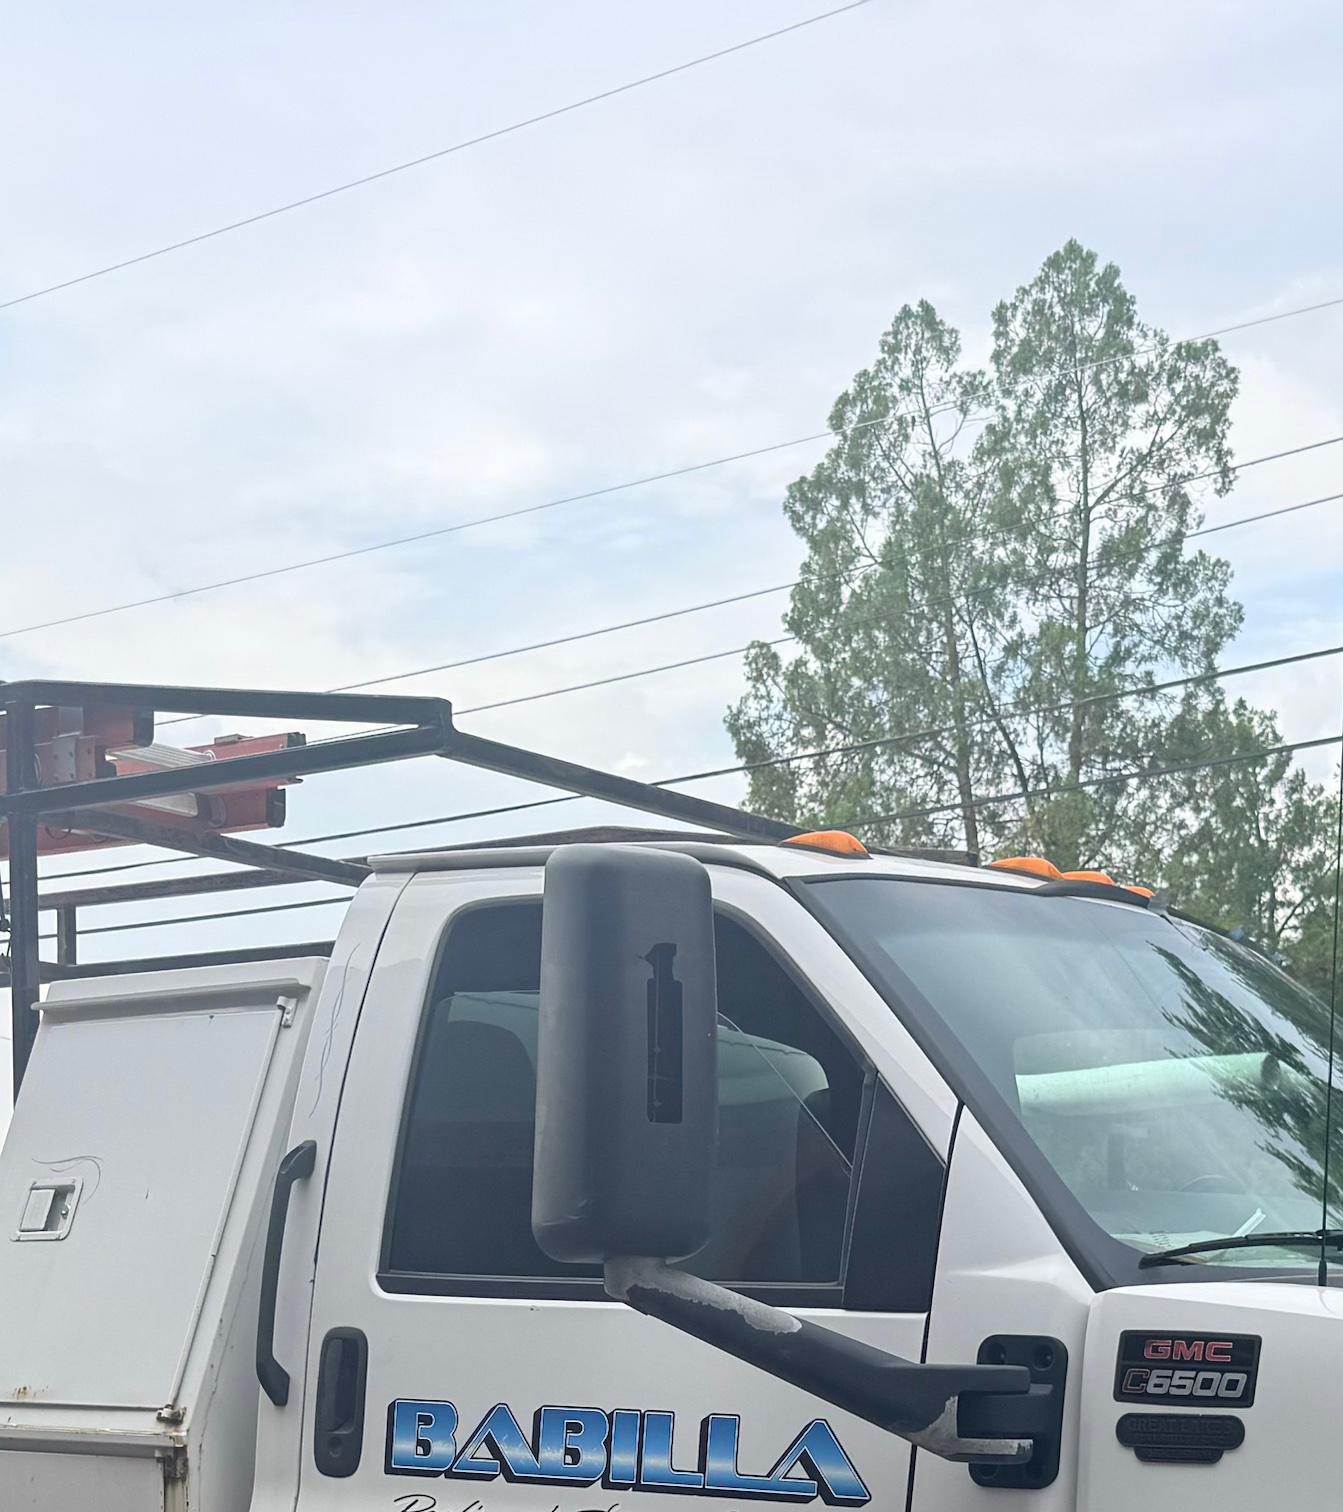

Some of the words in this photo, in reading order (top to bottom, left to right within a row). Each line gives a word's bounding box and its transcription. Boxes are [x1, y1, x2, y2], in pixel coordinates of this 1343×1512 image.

[1143, 1339, 1234, 1362] GMC
[1123, 1368, 1248, 1398] C6500
[384, 1398, 872, 1508] BABILLA
